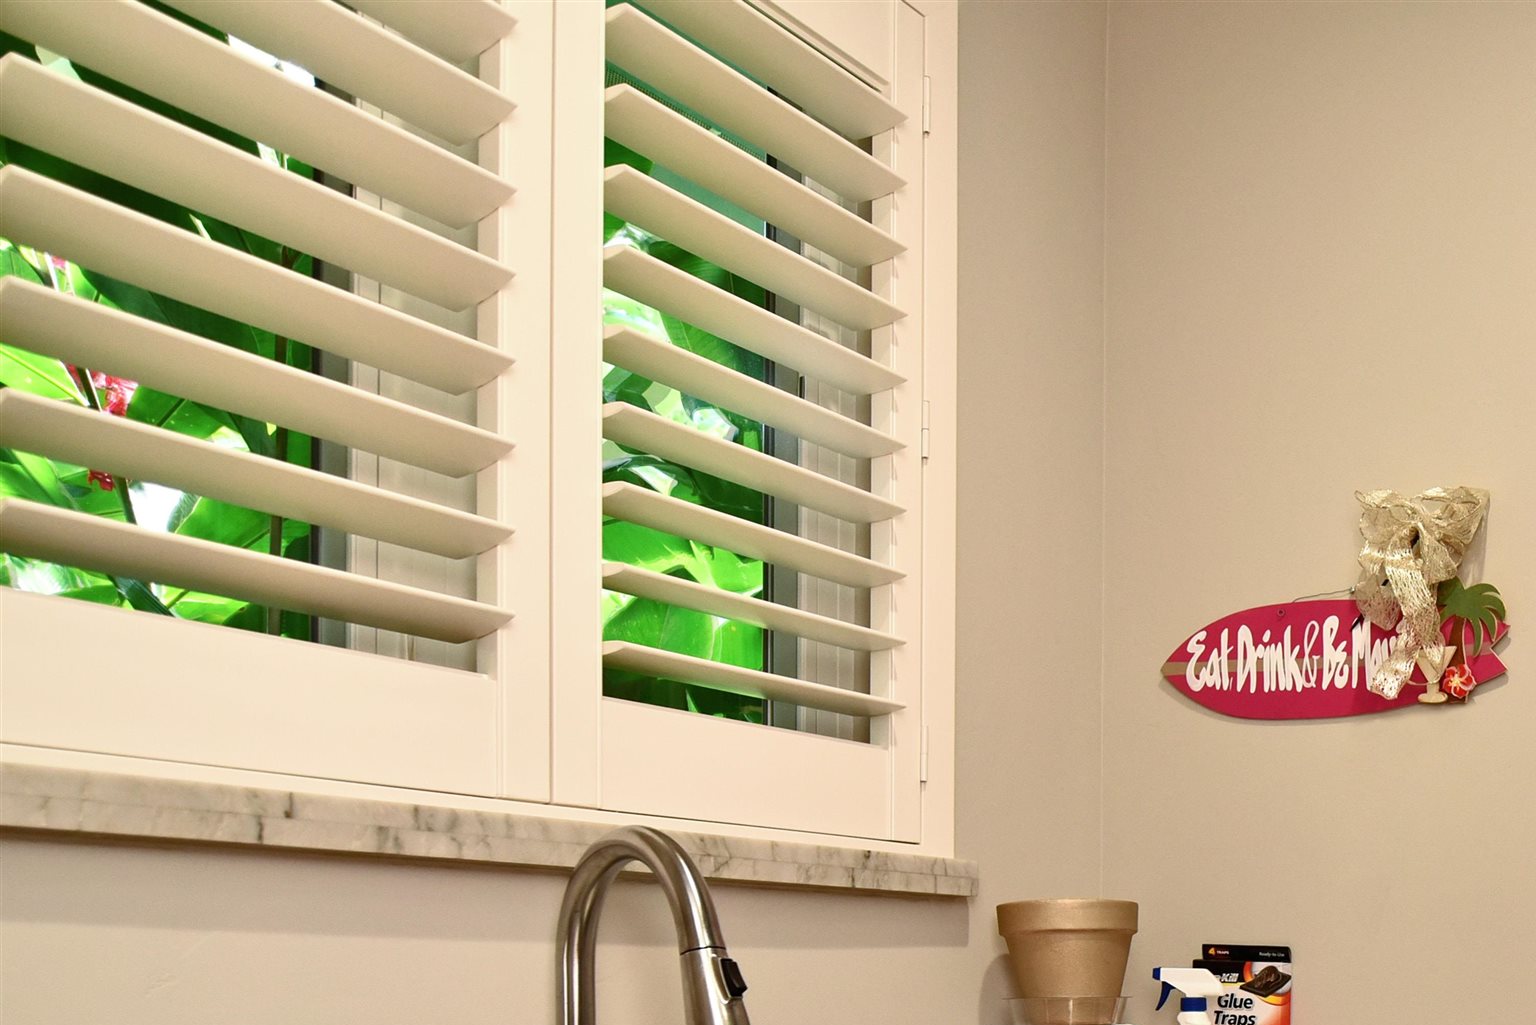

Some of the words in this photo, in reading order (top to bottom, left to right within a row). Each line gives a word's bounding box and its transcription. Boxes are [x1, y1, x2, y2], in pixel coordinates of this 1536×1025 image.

[1237, 624, 1303, 694] Drink
[1301, 620, 1320, 688] &
[1322, 615, 1349, 690] Be
[1208, 947, 1216, 955] 4
[1217, 993, 1253, 1009] Glue
